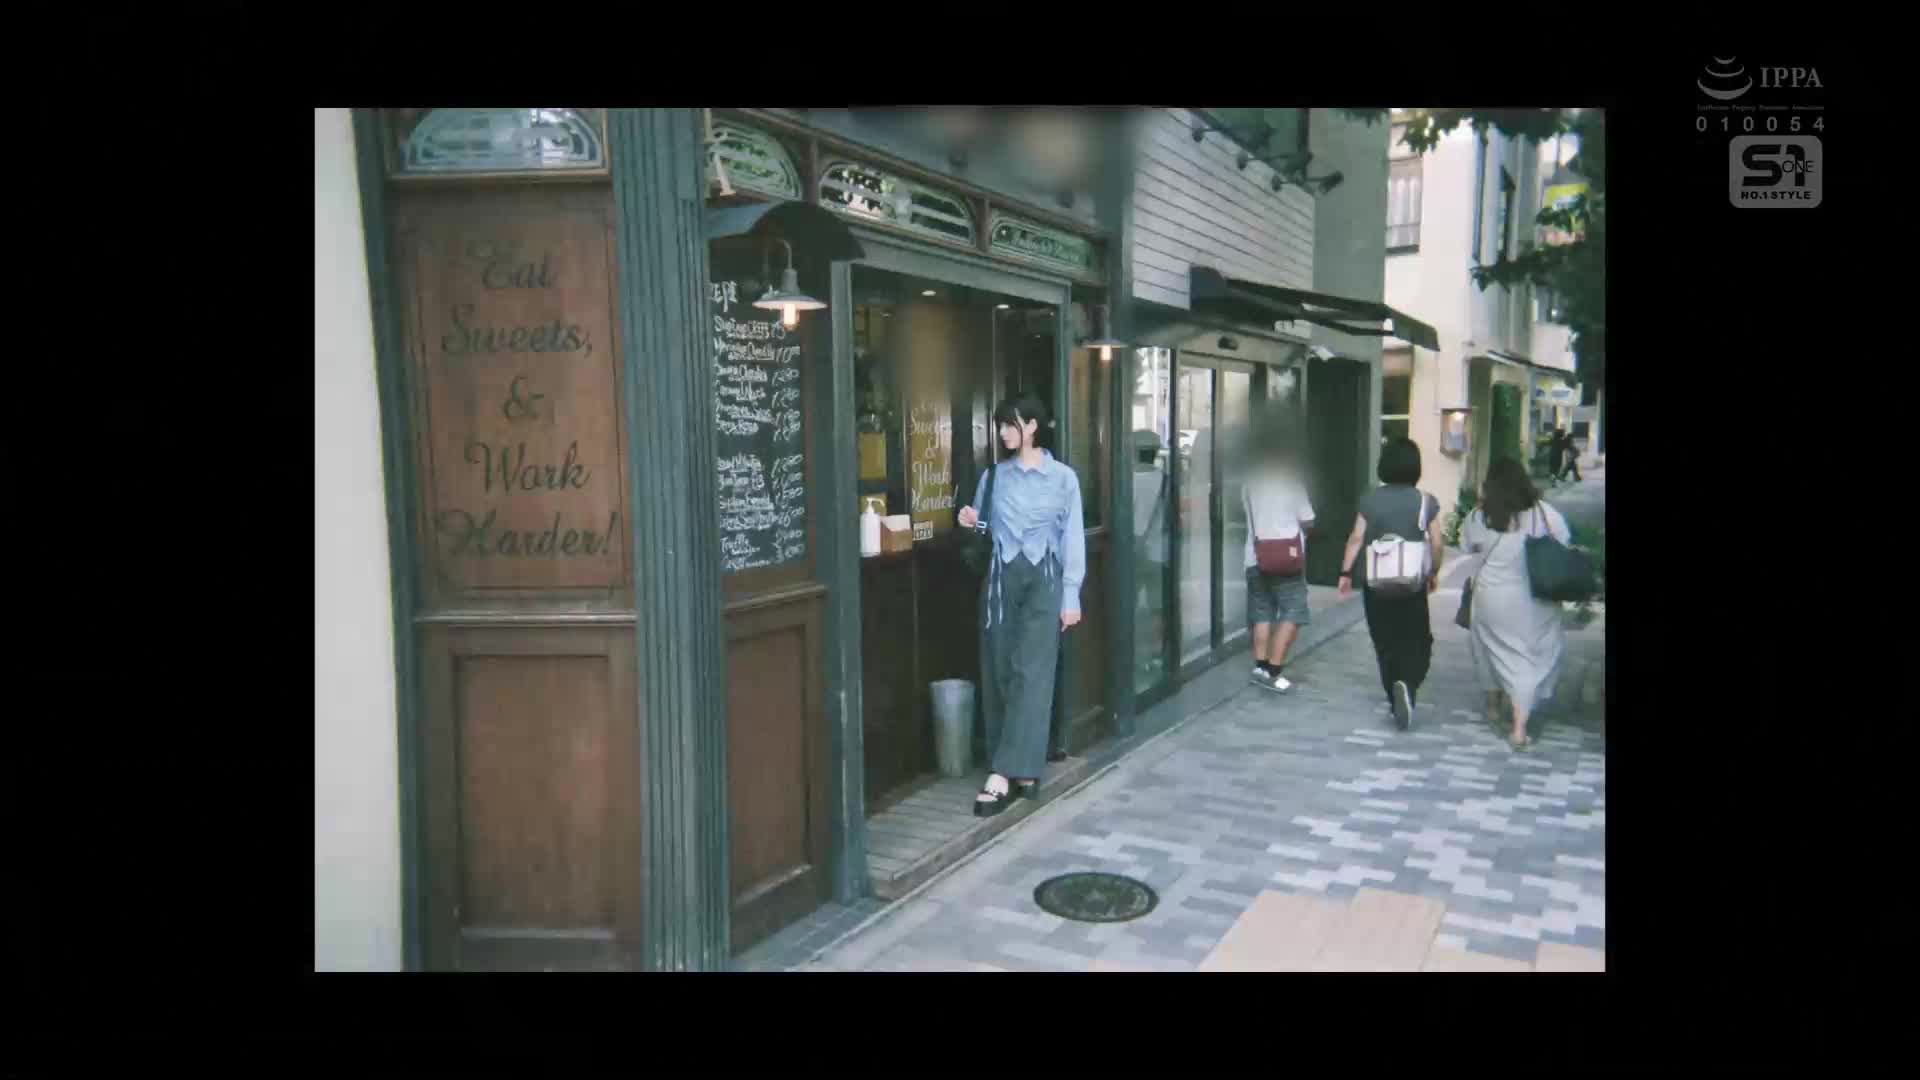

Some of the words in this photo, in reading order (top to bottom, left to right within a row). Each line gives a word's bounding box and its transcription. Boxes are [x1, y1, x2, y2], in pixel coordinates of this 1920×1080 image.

[472, 241, 556, 290] Eat
[441, 303, 595, 358] Sweets,
[502, 375, 545, 421] &
[463, 440, 592, 493] Work
[436, 507, 620, 557] Harder!
